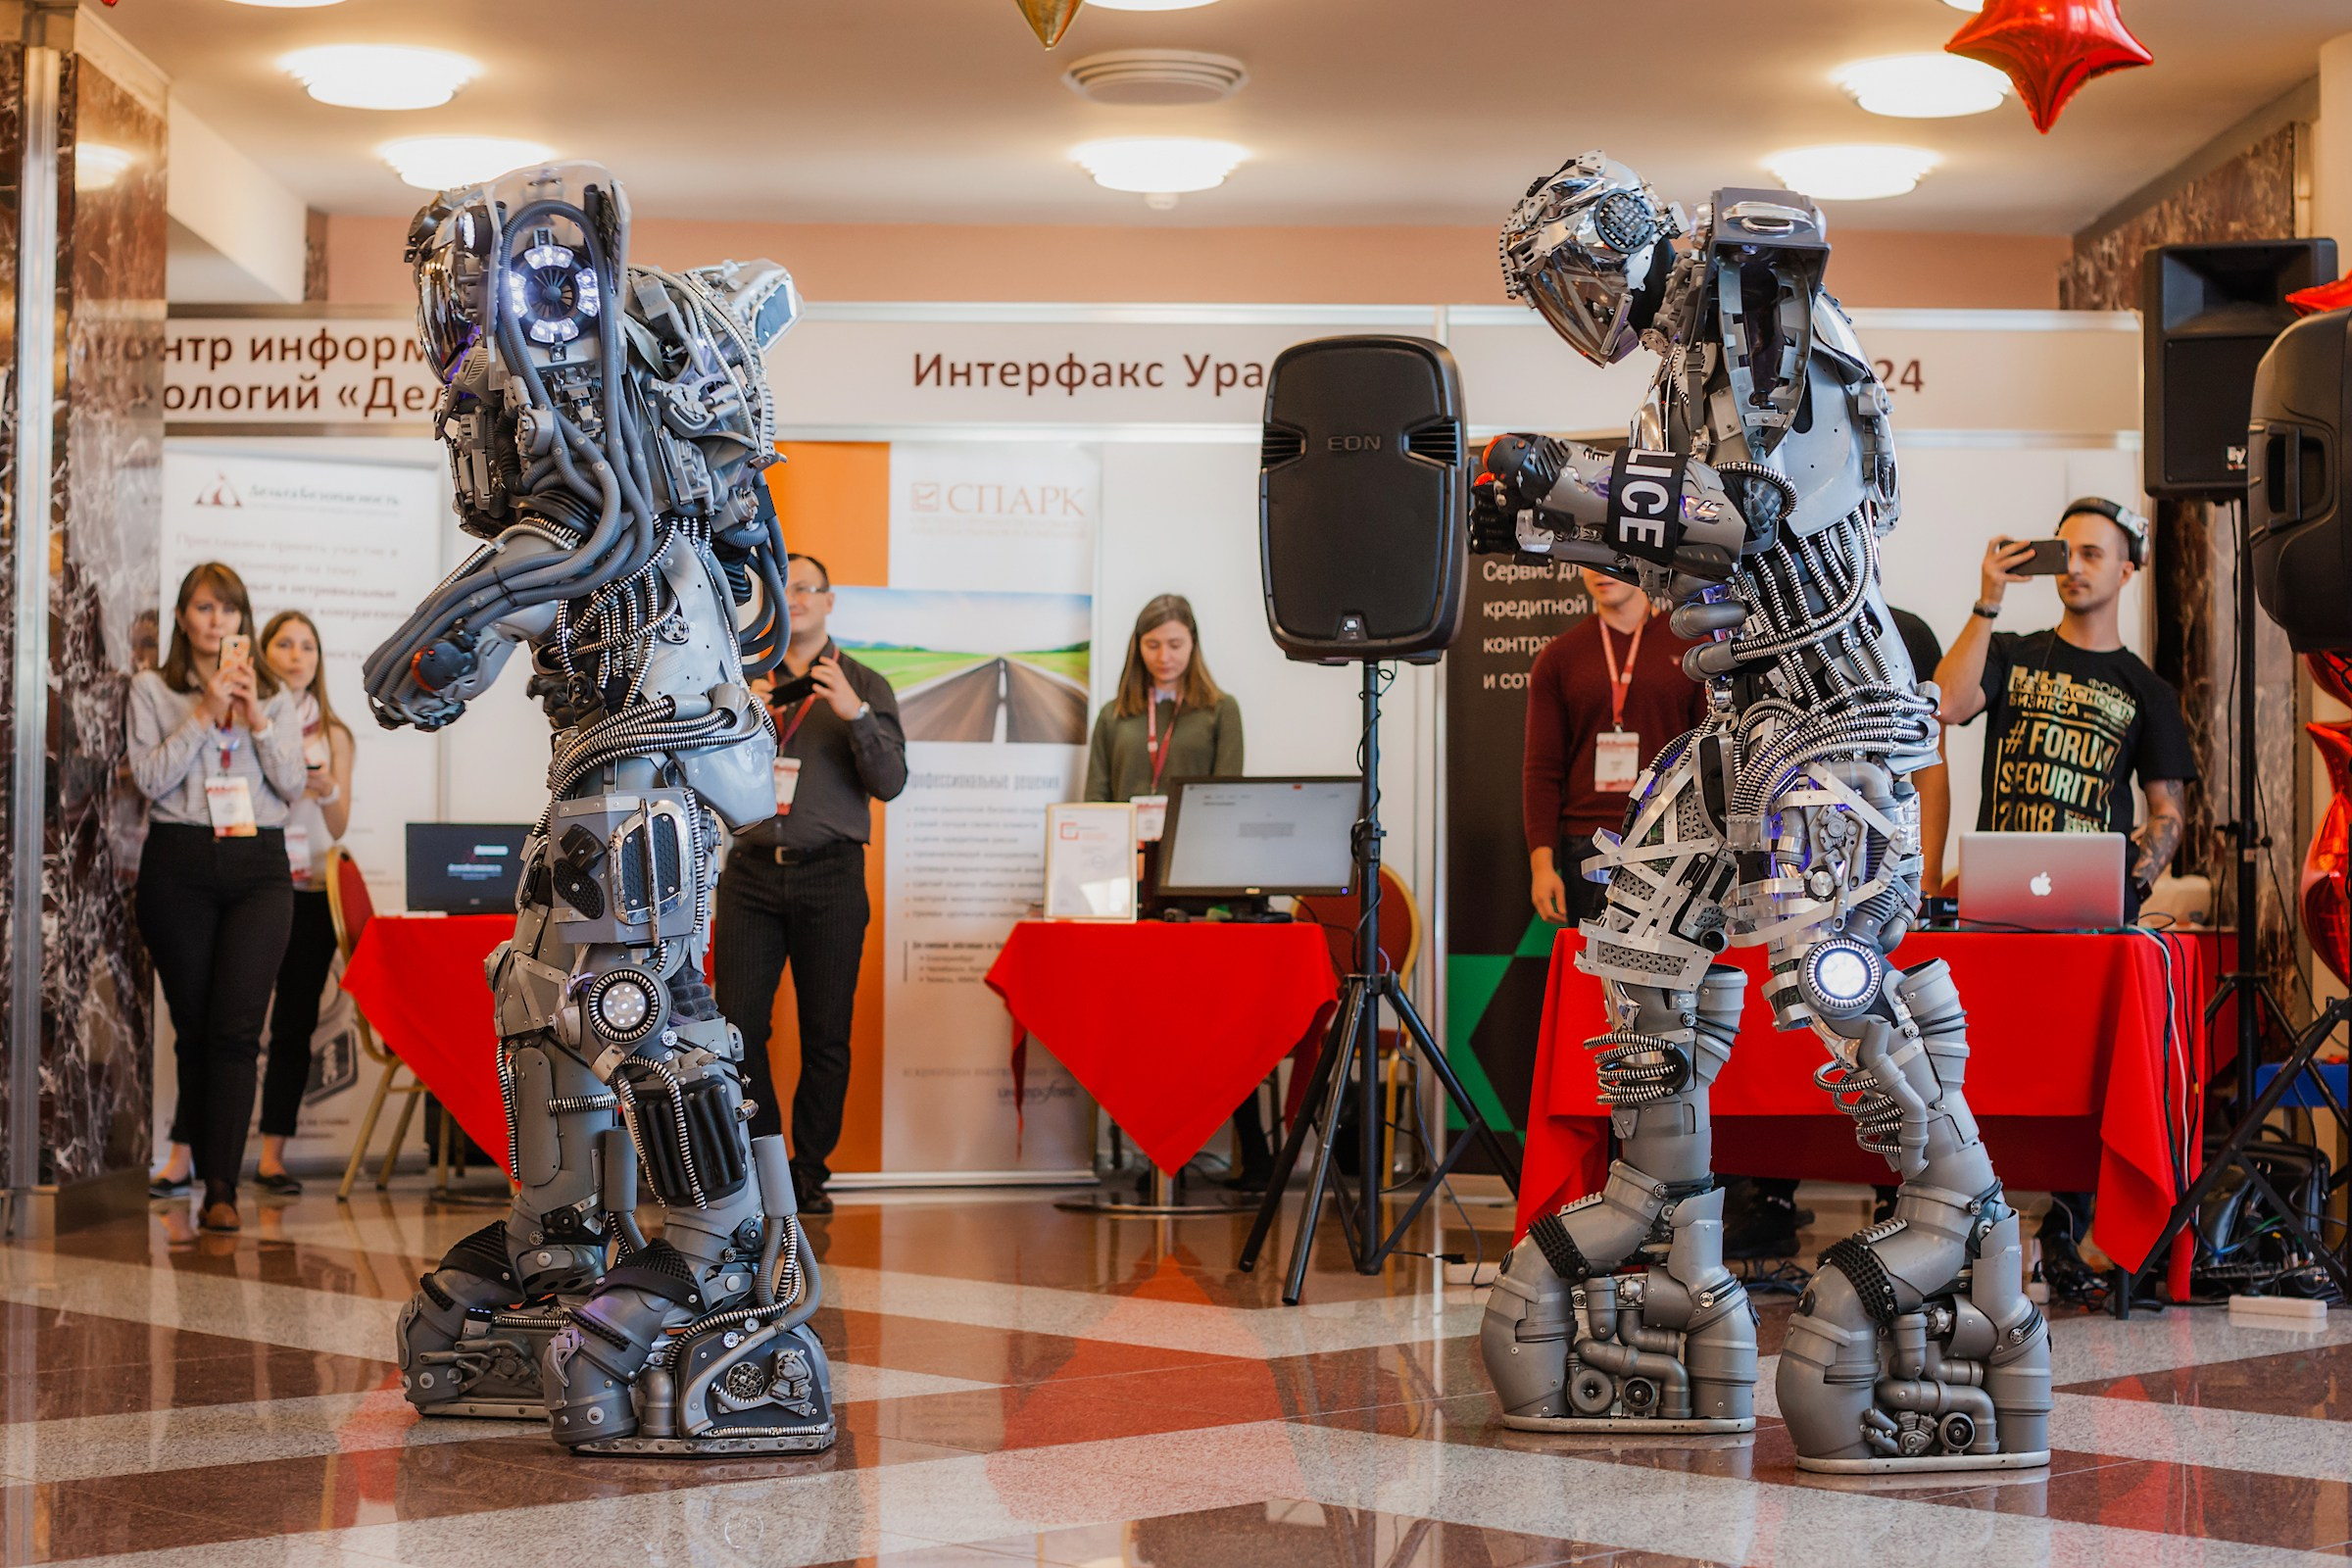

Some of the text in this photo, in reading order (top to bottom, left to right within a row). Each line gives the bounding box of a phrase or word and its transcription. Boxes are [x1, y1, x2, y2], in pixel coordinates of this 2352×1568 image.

[913, 352, 1264, 397] Интерфакс Ура
[1326, 434, 1382, 452] EON
[946, 482, 1085, 517] СПАРК
[1618, 447, 1678, 550] LICE
[1483, 560, 1554, 585] Сервис
[1483, 593, 1588, 621] кредитной
[1483, 673, 1496, 690] и
[1999, 760, 2110, 812] SECURITY
[1999, 801, 2057, 832] 2018
